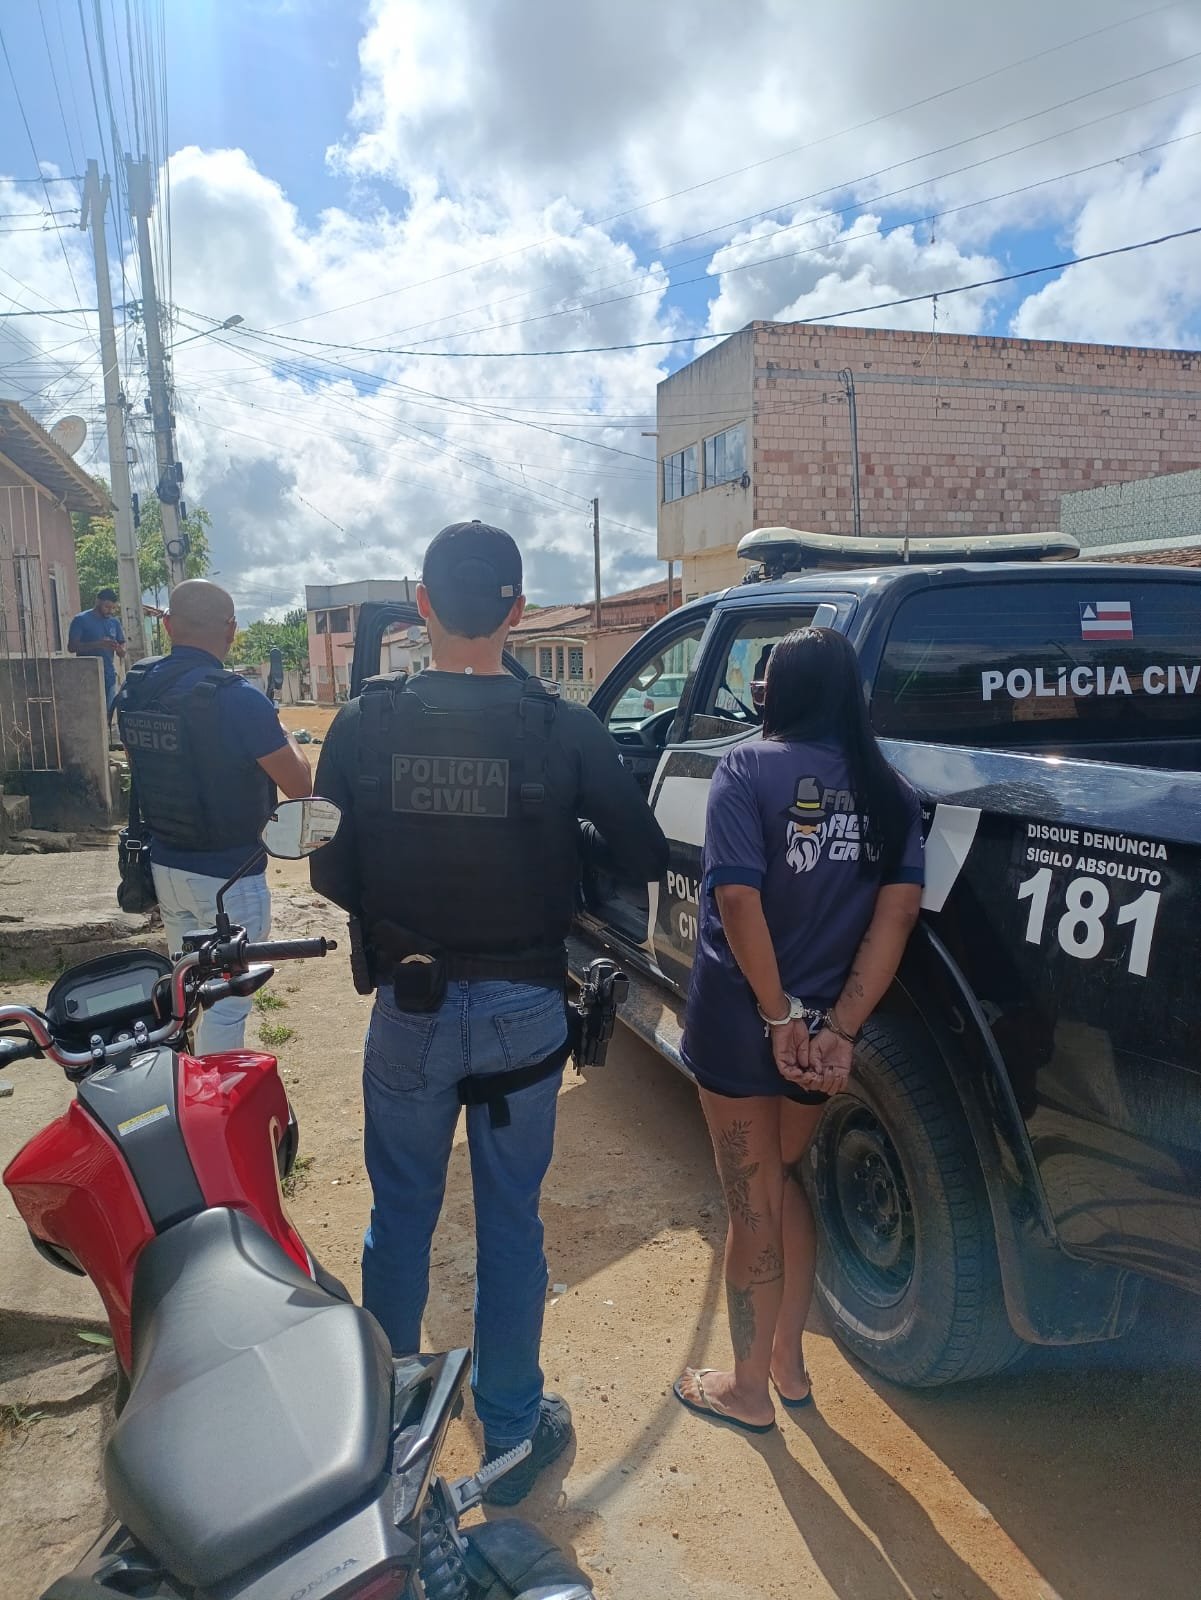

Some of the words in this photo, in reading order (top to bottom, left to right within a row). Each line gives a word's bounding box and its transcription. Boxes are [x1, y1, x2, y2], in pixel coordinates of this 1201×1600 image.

[1142, 665, 1201, 695] CIV
[125, 728, 178, 752] DEIC
[410, 786, 487, 813] CIVIL
[1027, 824, 1080, 846] DISQUE
[1083, 832, 1167, 861] DENÚNCIA
[1026, 847, 1073, 869] SIGILO
[1075, 856, 1162, 887] ABSOLUTO
[1016, 867, 1162, 978] 181
